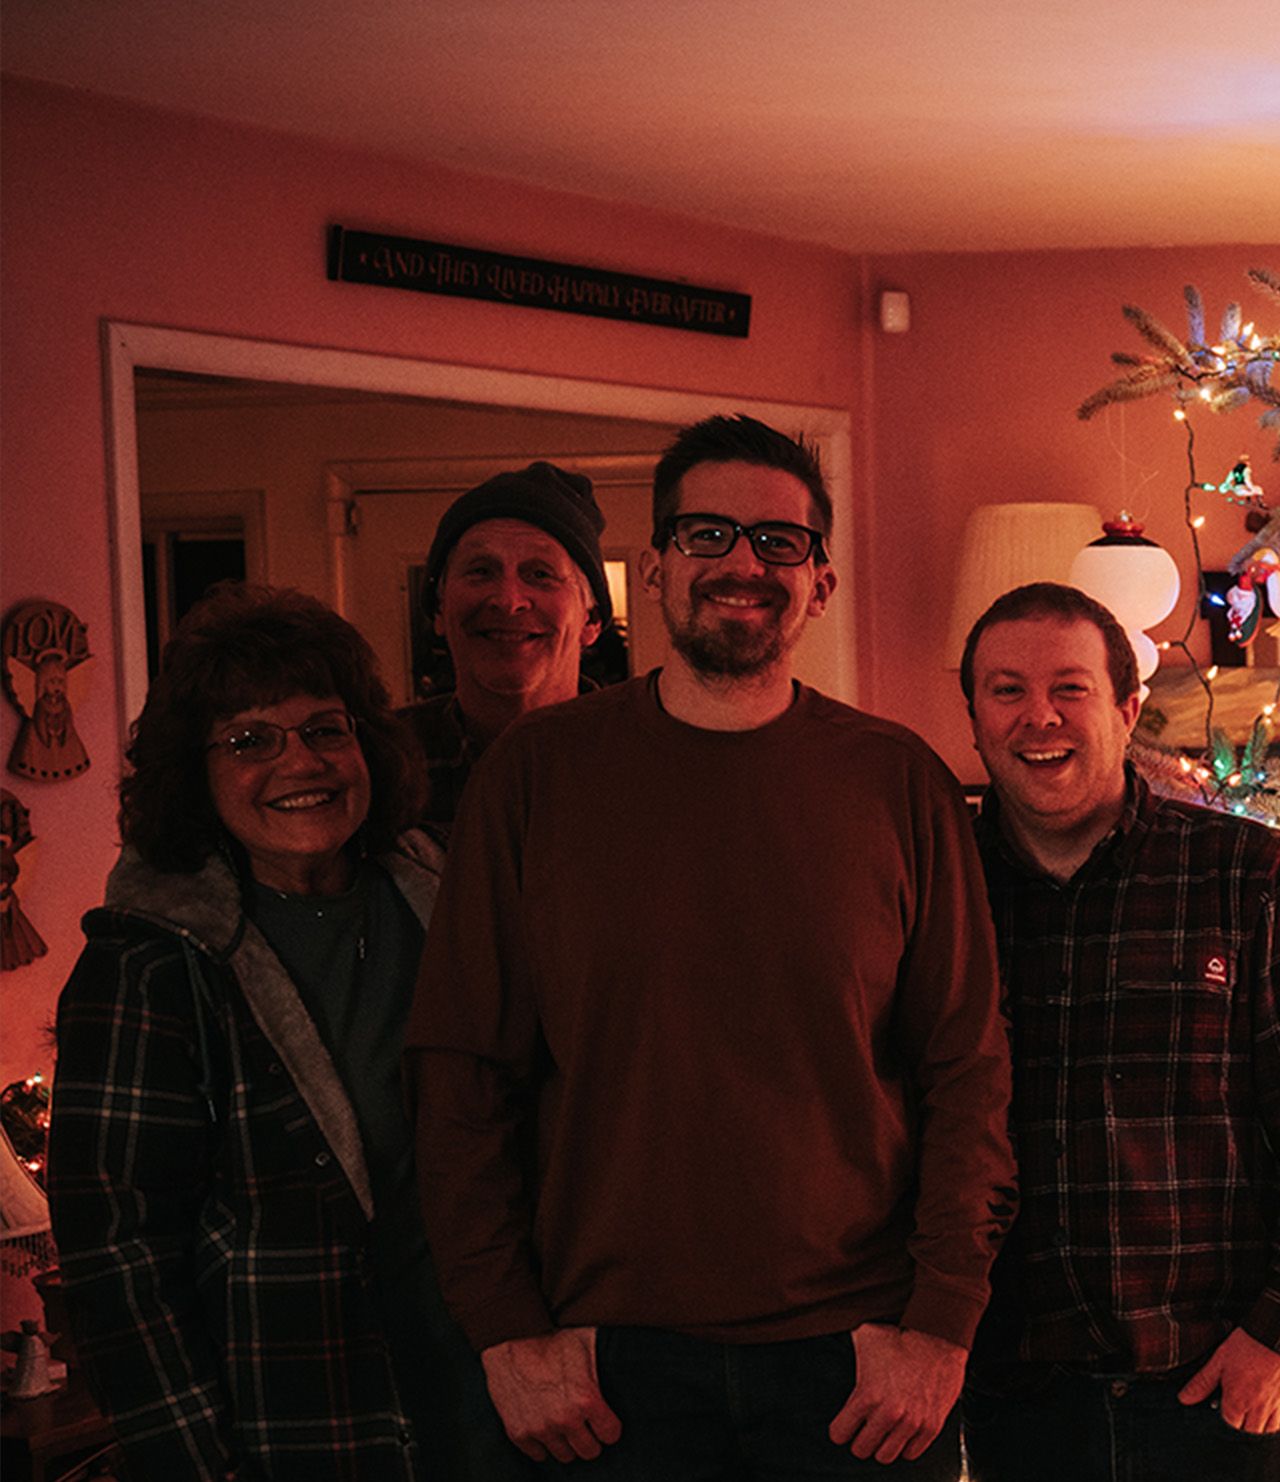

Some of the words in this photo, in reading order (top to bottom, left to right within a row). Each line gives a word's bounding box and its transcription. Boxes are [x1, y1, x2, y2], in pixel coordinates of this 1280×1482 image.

[373, 247, 426, 280] AND
[429, 250, 480, 288] THEY
[486, 264, 546, 299] LIVED
[547, 272, 622, 309] HAPPILY
[626, 286, 672, 316] EVER
[674, 295, 726, 324] AFTER
[14, 611, 88, 661] LOVE
